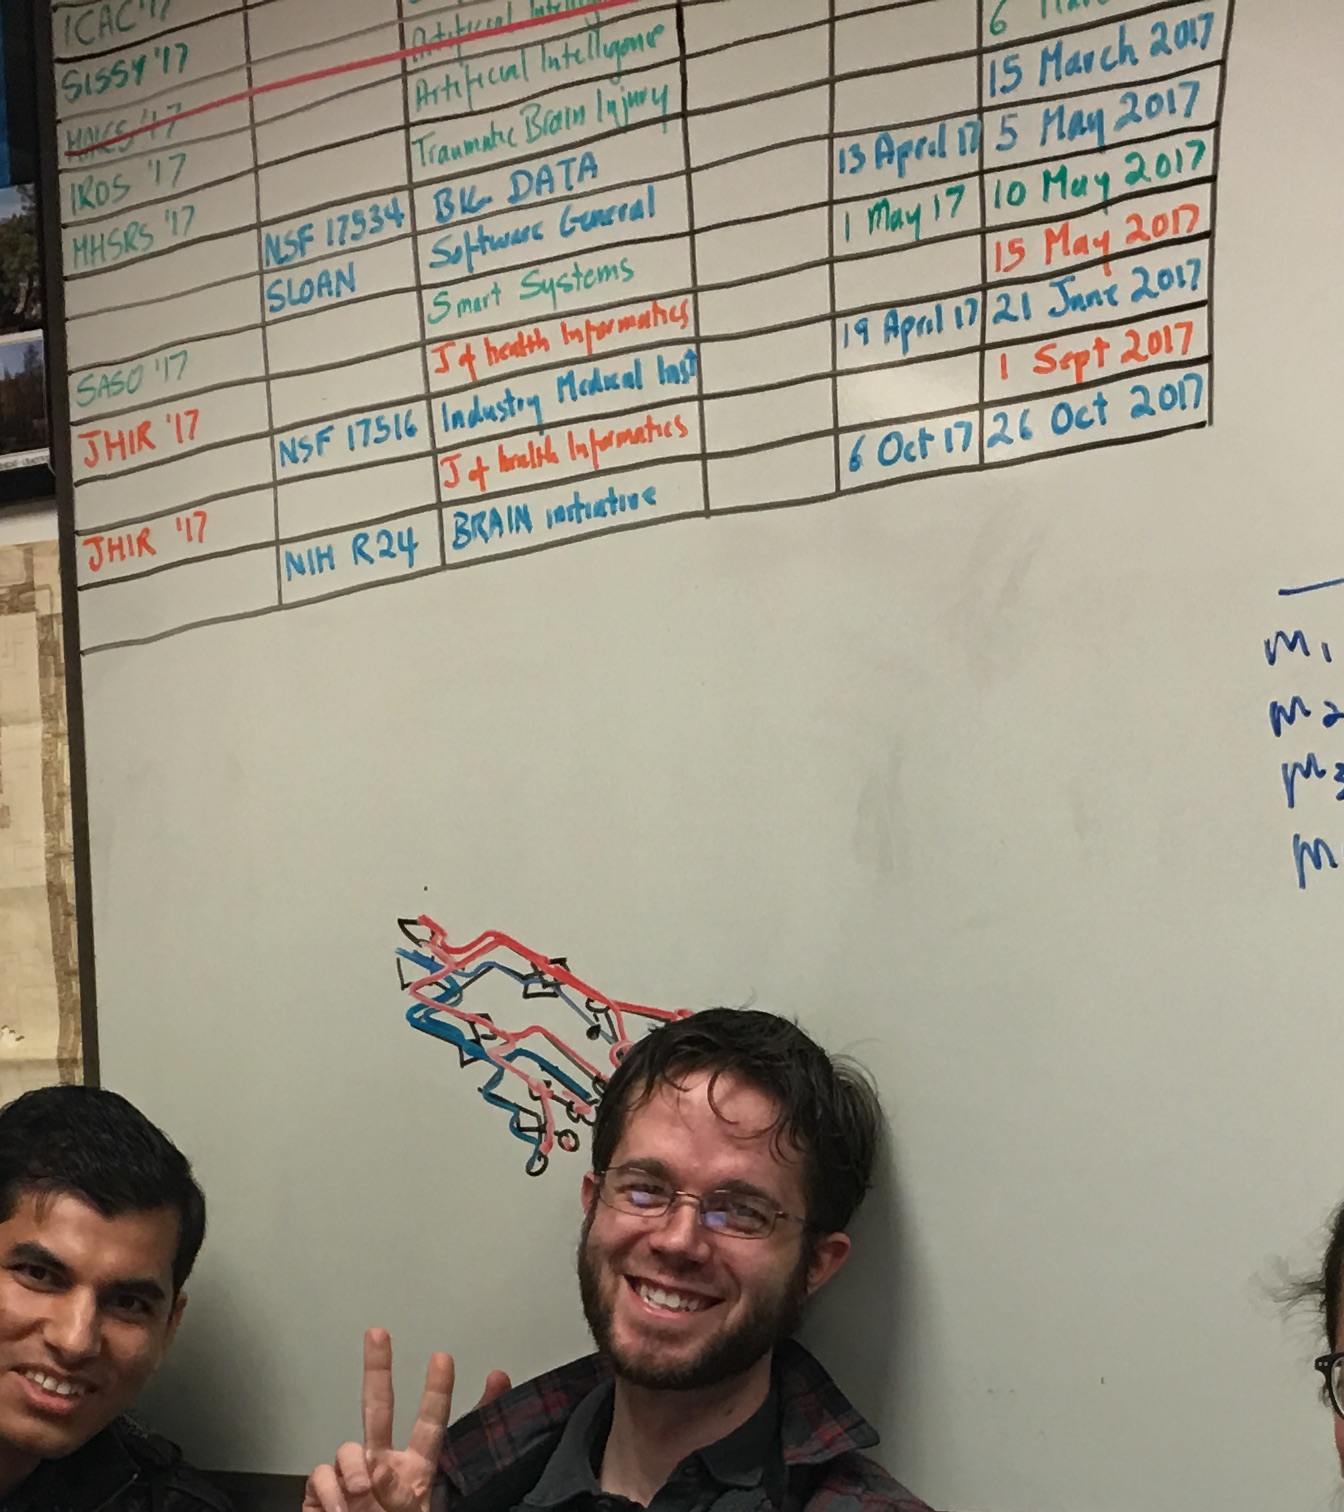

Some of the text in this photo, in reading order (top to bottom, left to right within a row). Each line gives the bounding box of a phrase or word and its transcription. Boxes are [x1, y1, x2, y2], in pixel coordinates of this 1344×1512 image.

[64, 5, 136, 47] ICAC
[989, 12, 1214, 97] 15 March 2017
[61, 55, 146, 103] SISSY
[412, 84, 669, 166] Traumatic Brain Injury
[996, 81, 1200, 152] 5 May 2017
[508, 151, 598, 204] DATA
[839, 121, 981, 178] 13 April 17
[994, 139, 1206, 214] 10 May 2017
[71, 174, 131, 215] IROS
[867, 184, 965, 240] May 17
[264, 224, 314, 268] NSF
[429, 184, 655, 273] Software General
[996, 203, 1200, 276] 15 May 2017
[267, 262, 356, 313] SLOAN
[428, 257, 634, 324] Smart Systems
[993, 258, 1201, 325] 21 June 2017
[843, 298, 978, 356] 19 April 17
[1033, 321, 1194, 383] Sept 2017
[76, 365, 143, 407] SASO
[441, 358, 644, 436] Industry Medical
[987, 373, 1203, 449] 26 Oct 2017
[78, 420, 156, 468] JHIR
[278, 409, 418, 467] NSF 17516
[877, 421, 973, 467] Oct 17
[82, 527, 157, 572] JHIR
[284, 526, 419, 582] NIH R24
[452, 503, 533, 550] BRAIN
